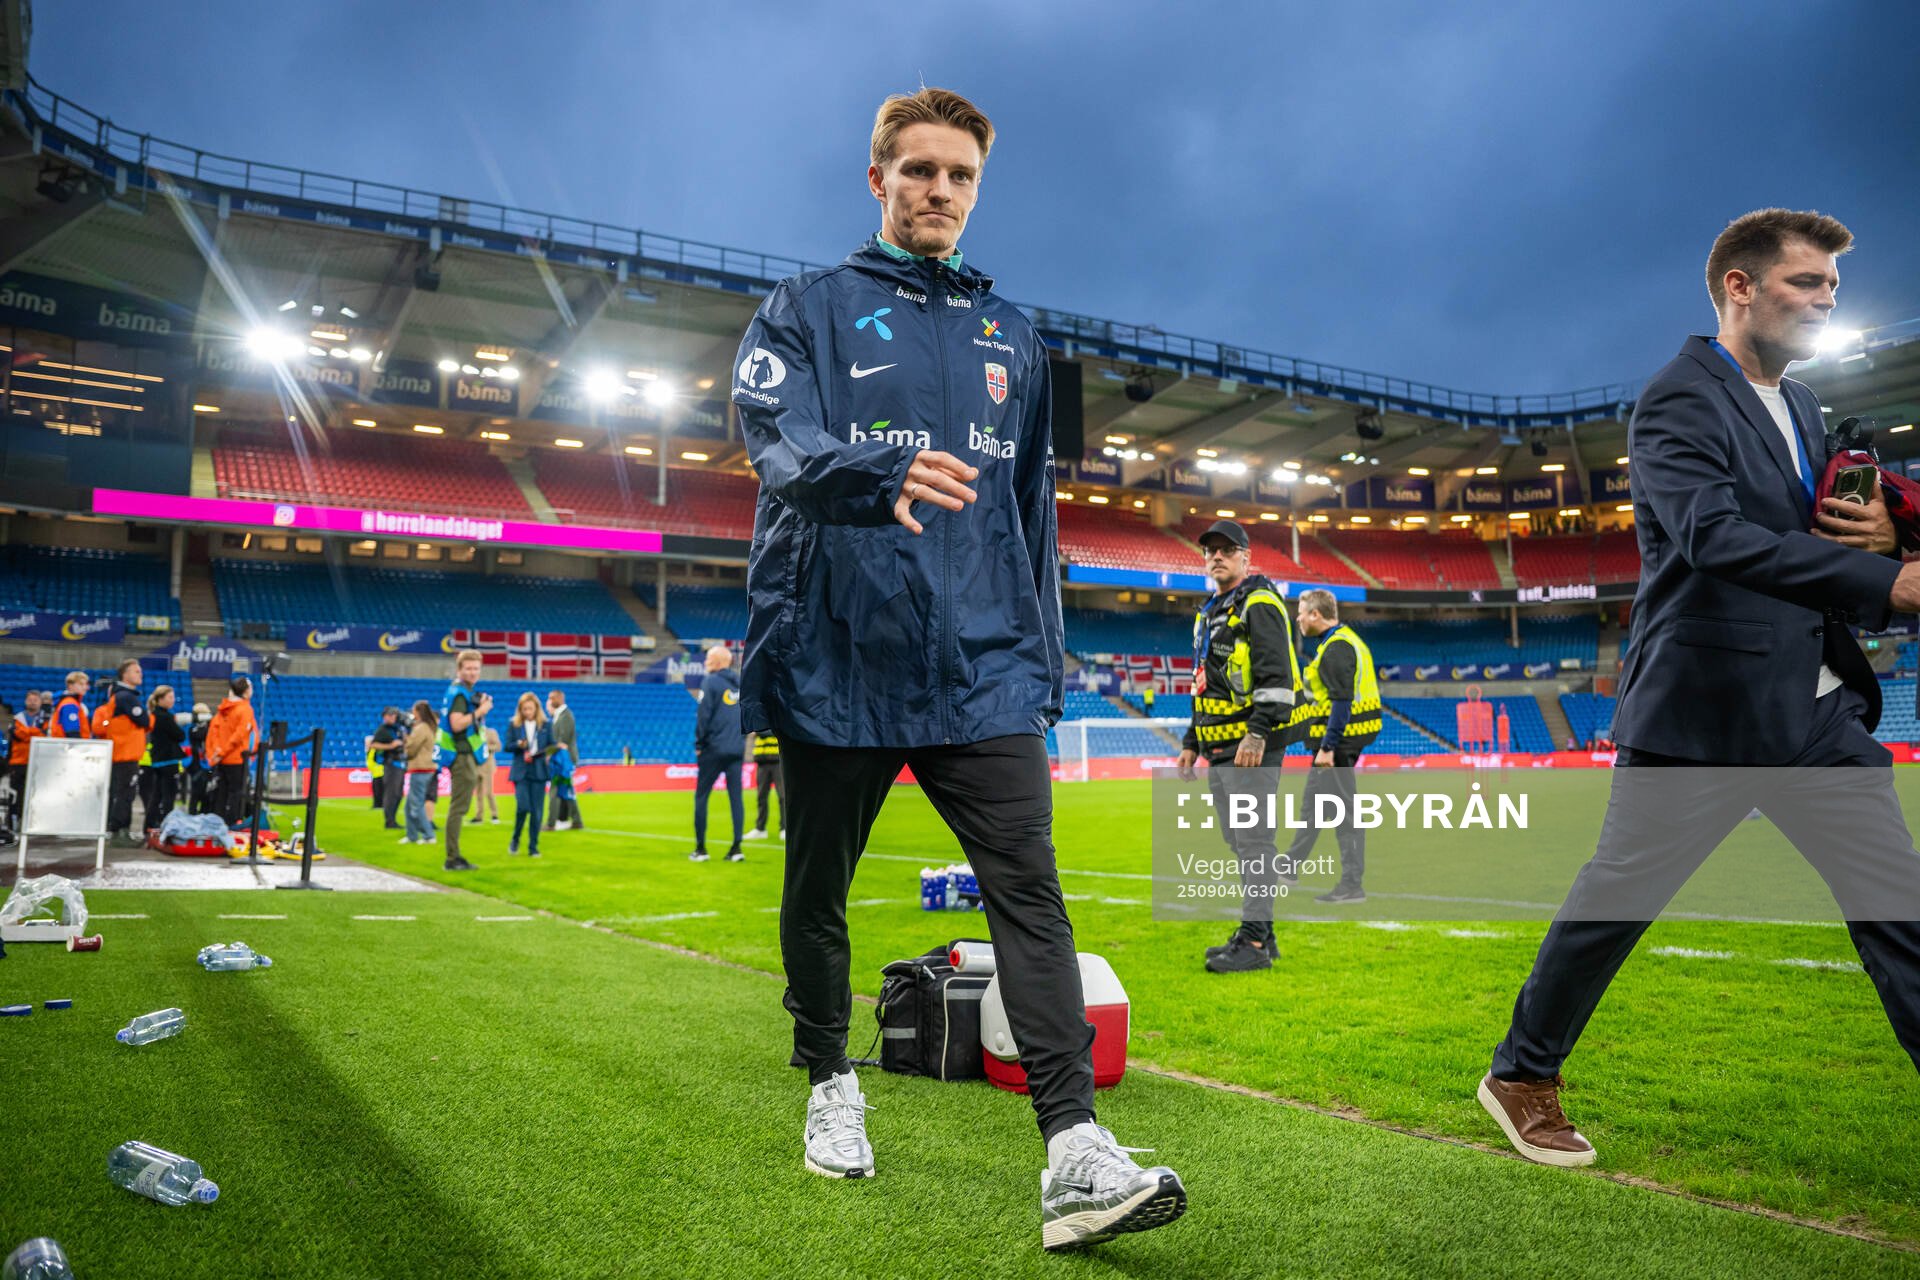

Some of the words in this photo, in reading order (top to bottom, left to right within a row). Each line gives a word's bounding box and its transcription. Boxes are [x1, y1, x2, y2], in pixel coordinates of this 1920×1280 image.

[0, 288, 57, 316] ama
[896, 286, 927, 304] bama
[947, 295, 972, 309] bama
[99, 303, 171, 334] bama
[457, 379, 512, 403] bama
[969, 423, 1016, 459] bama
[1081, 458, 1117, 476] bama
[1385, 485, 1421, 502] bama
[1466, 486, 1501, 503] bama
[1513, 486, 1553, 503] bama
[72, 618, 110, 635] Bendit
[178, 641, 237, 663] bama
